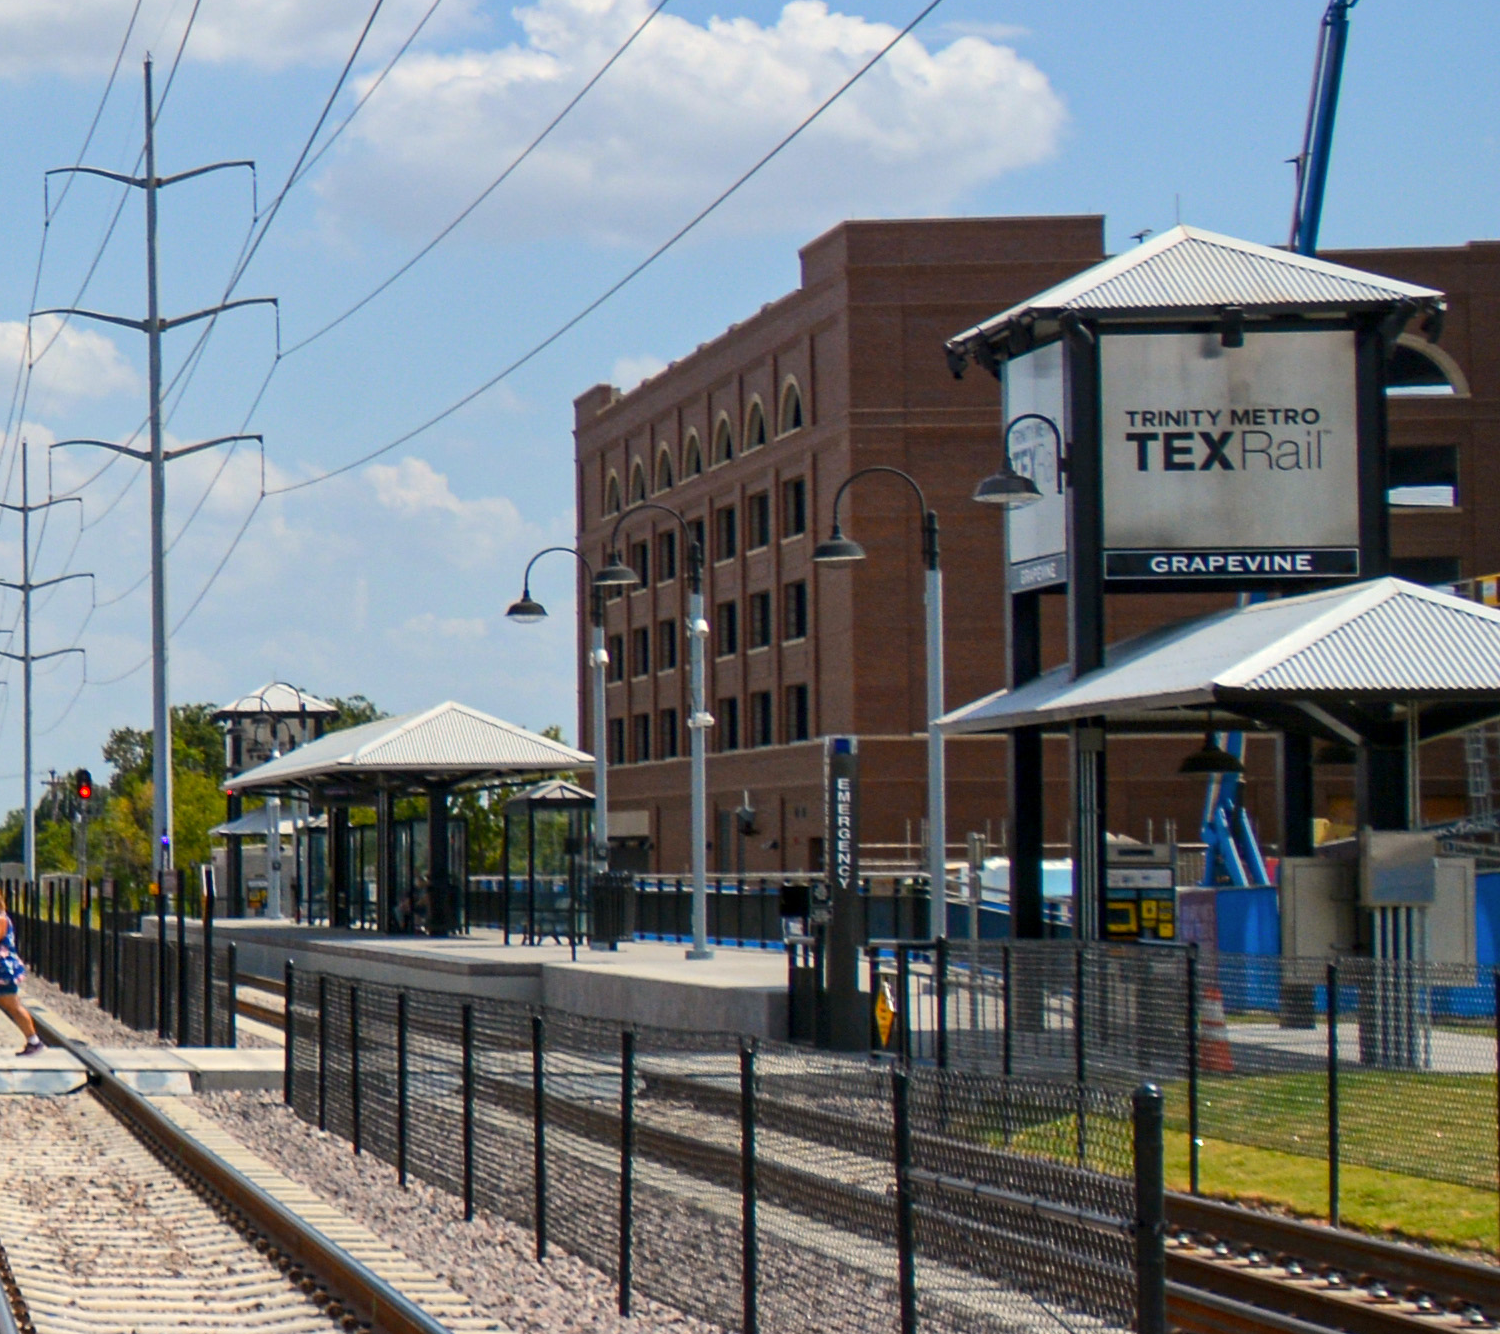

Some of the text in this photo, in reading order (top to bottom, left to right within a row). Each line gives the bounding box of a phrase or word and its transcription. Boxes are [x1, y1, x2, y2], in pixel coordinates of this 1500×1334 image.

[1124, 407, 1320, 427] TRINITY METRO
[1150, 554, 1313, 573] GRAPEVINE
[836, 777, 851, 889] EMERGENCY
